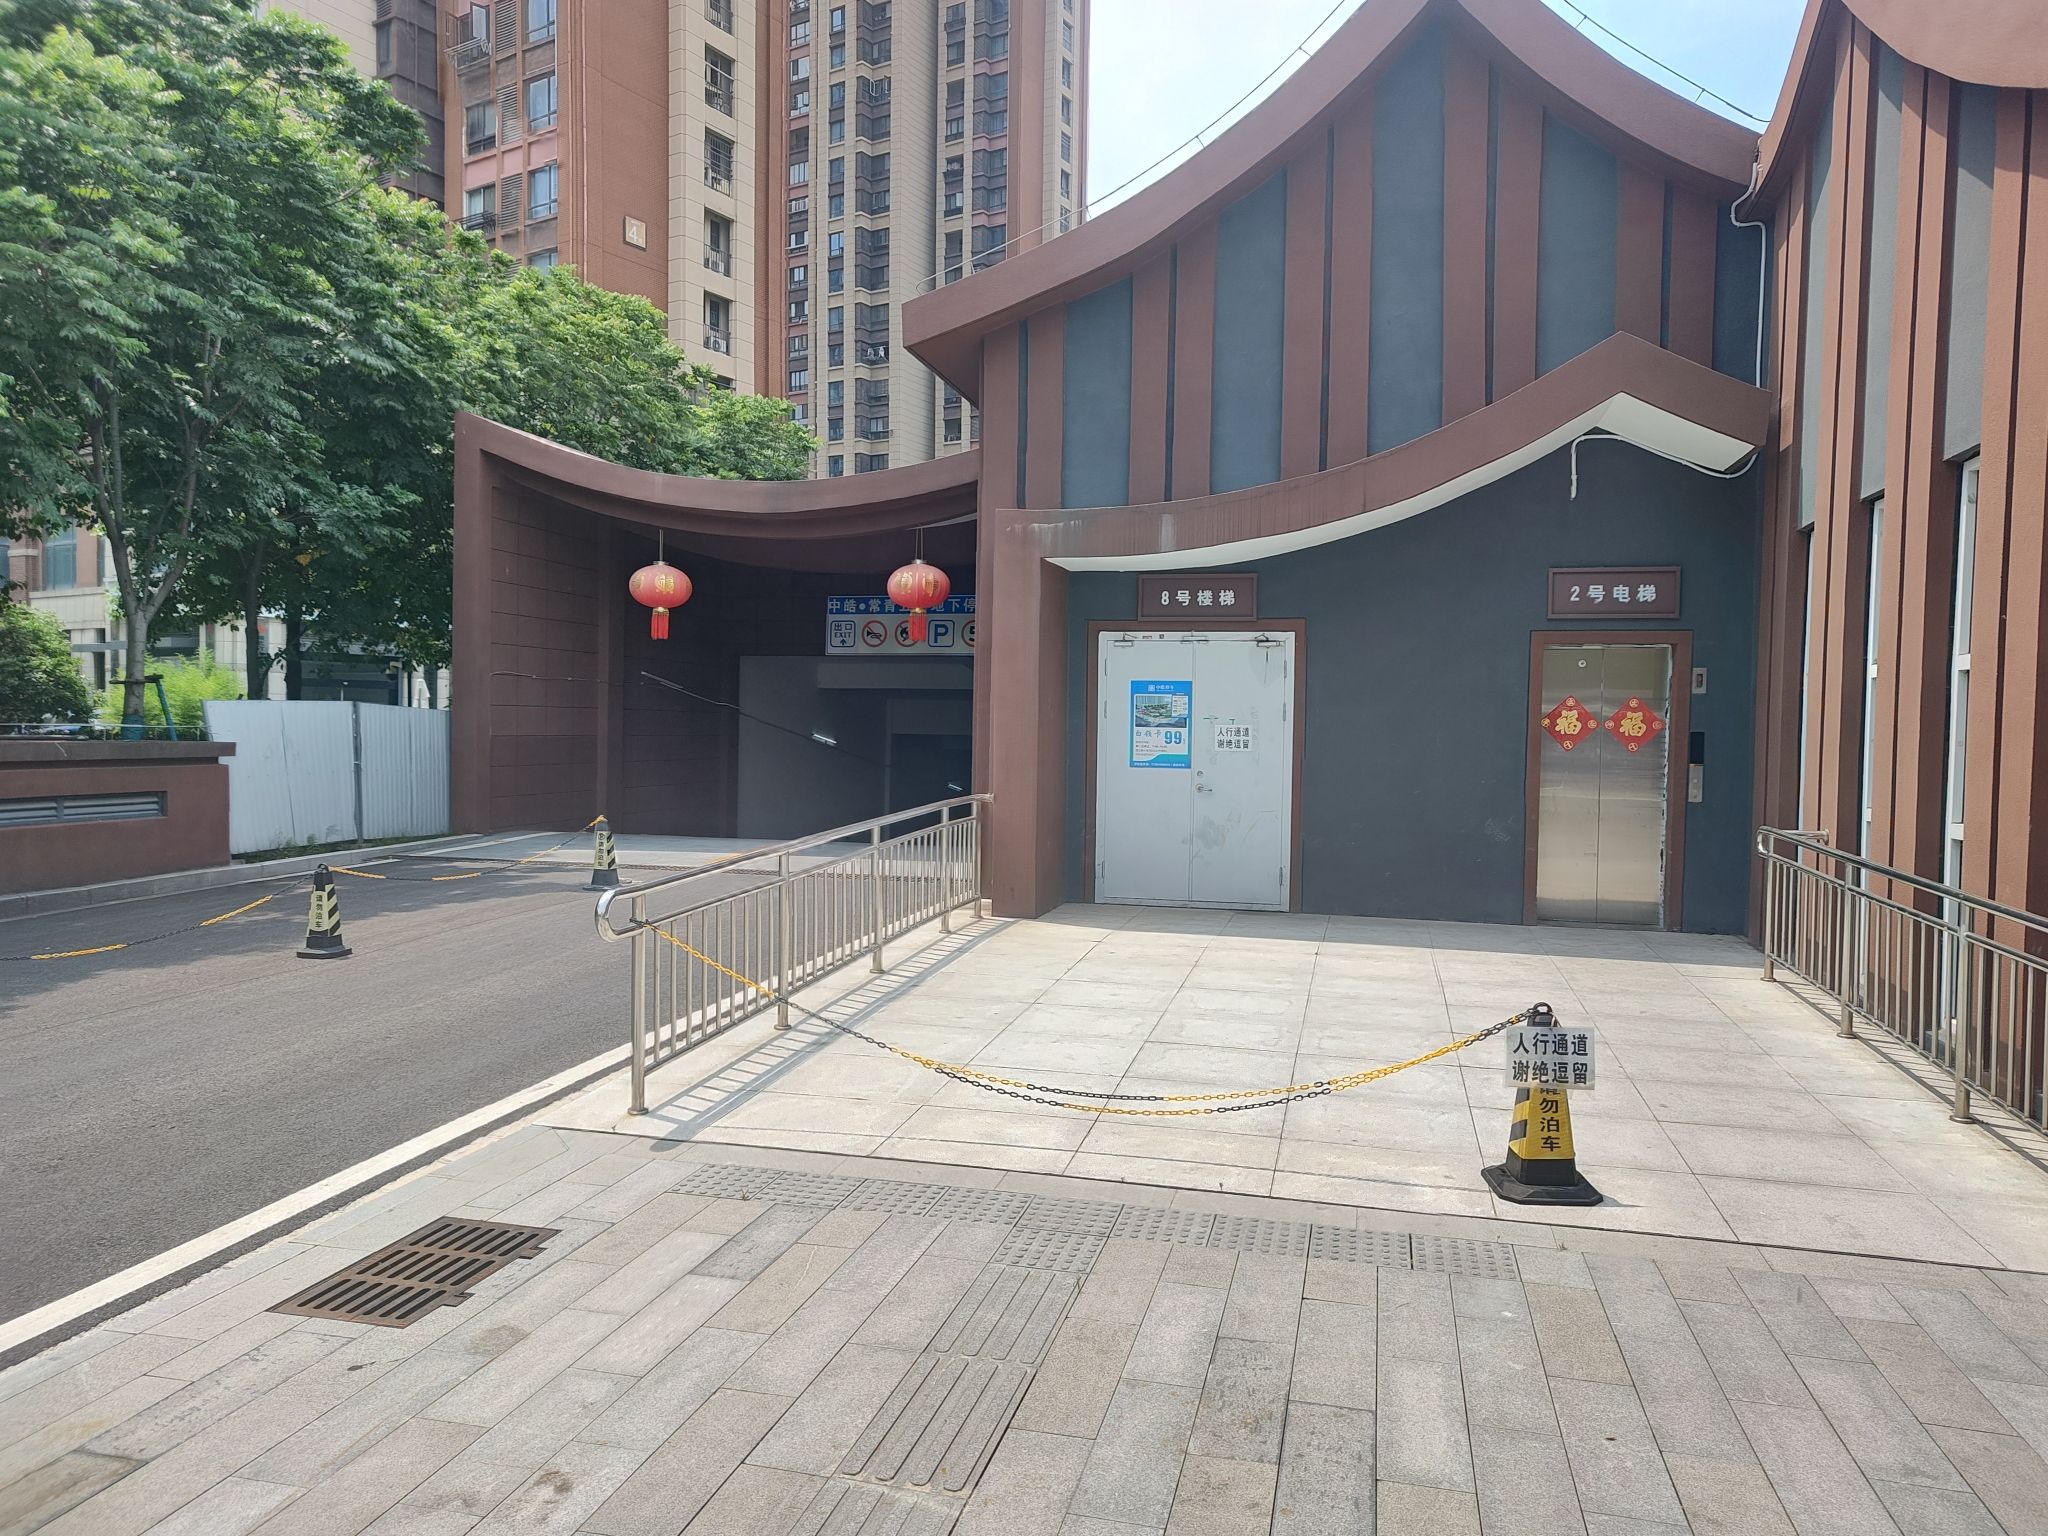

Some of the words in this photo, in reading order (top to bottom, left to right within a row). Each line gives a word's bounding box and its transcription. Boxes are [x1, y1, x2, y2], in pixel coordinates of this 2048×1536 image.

[629, 225, 638, 242] 4
[1161, 590, 1235, 606] 8号楼梯
[1569, 584, 1657, 603] 2号电梯
[834, 623, 852, 631] 出口
[1555, 709, 1582, 735] 福
[1619, 711, 1647, 737] 福
[1164, 731, 1182, 744] 99
[1217, 727, 1249, 737] 人行通道
[1217, 739, 1249, 749] 谢绝逗留
[1512, 1032, 1589, 1057] 人行通道
[1512, 1059, 1589, 1085] 谢绝逗留
